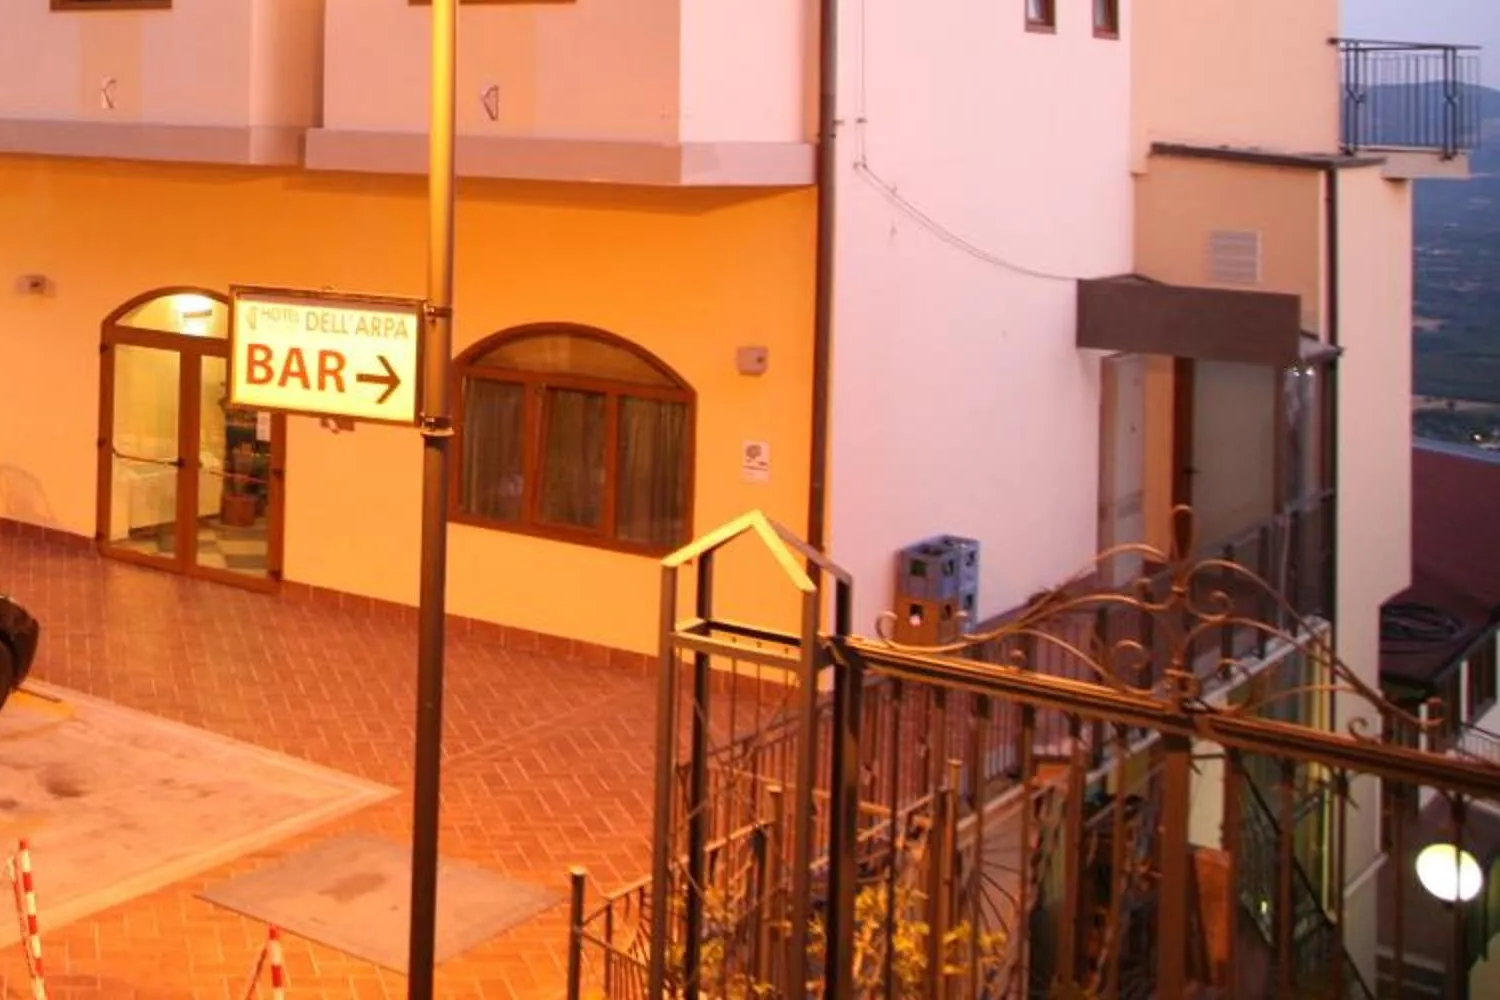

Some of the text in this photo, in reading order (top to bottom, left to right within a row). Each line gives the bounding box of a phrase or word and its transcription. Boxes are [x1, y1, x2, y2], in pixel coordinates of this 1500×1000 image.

[261, 307, 409, 339] HOTEL DELL'ARPA
[246, 343, 347, 393] BAR
